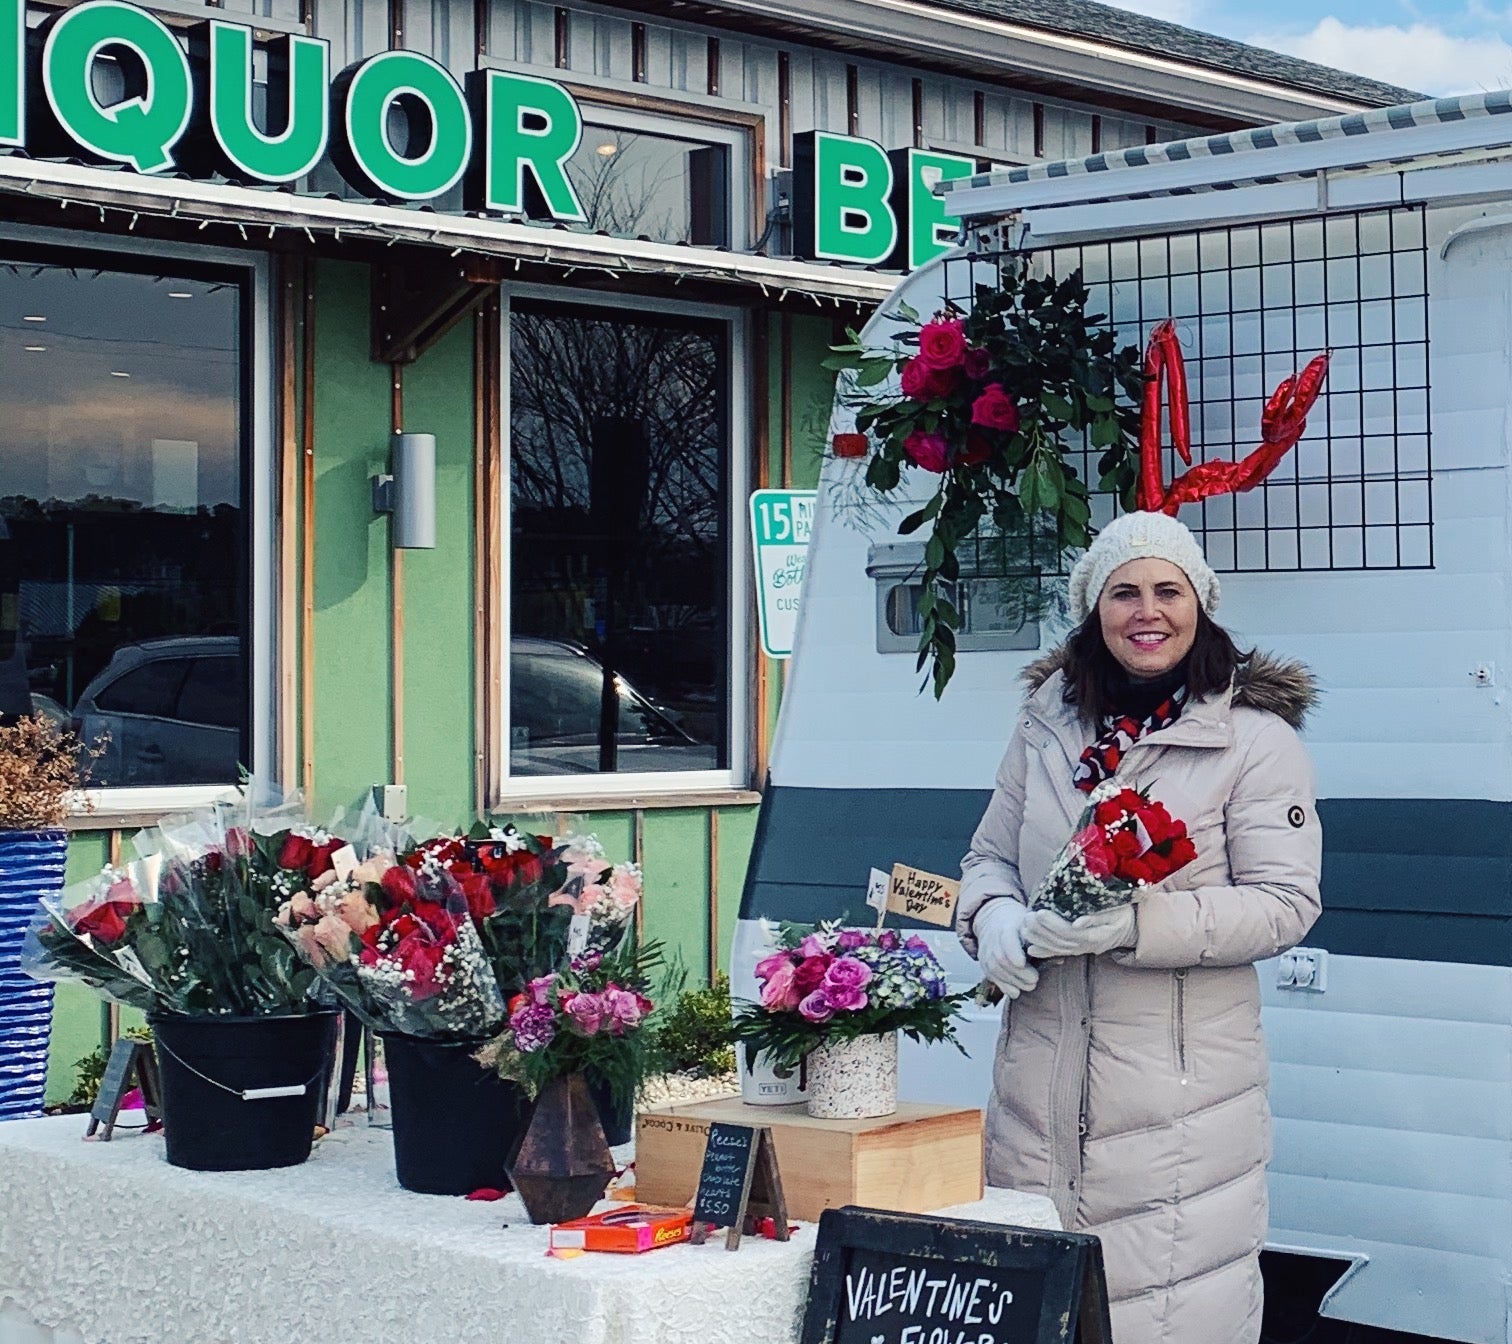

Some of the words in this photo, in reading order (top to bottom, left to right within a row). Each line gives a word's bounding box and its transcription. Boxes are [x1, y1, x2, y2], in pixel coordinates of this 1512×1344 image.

[814, 130, 977, 271] BE
[758, 502, 791, 541] 15
[907, 871, 943, 893] Happy
[906, 898, 927, 914] Day
[761, 1085, 785, 1094] YETI
[846, 1266, 1014, 1325] VALENTINE'S
